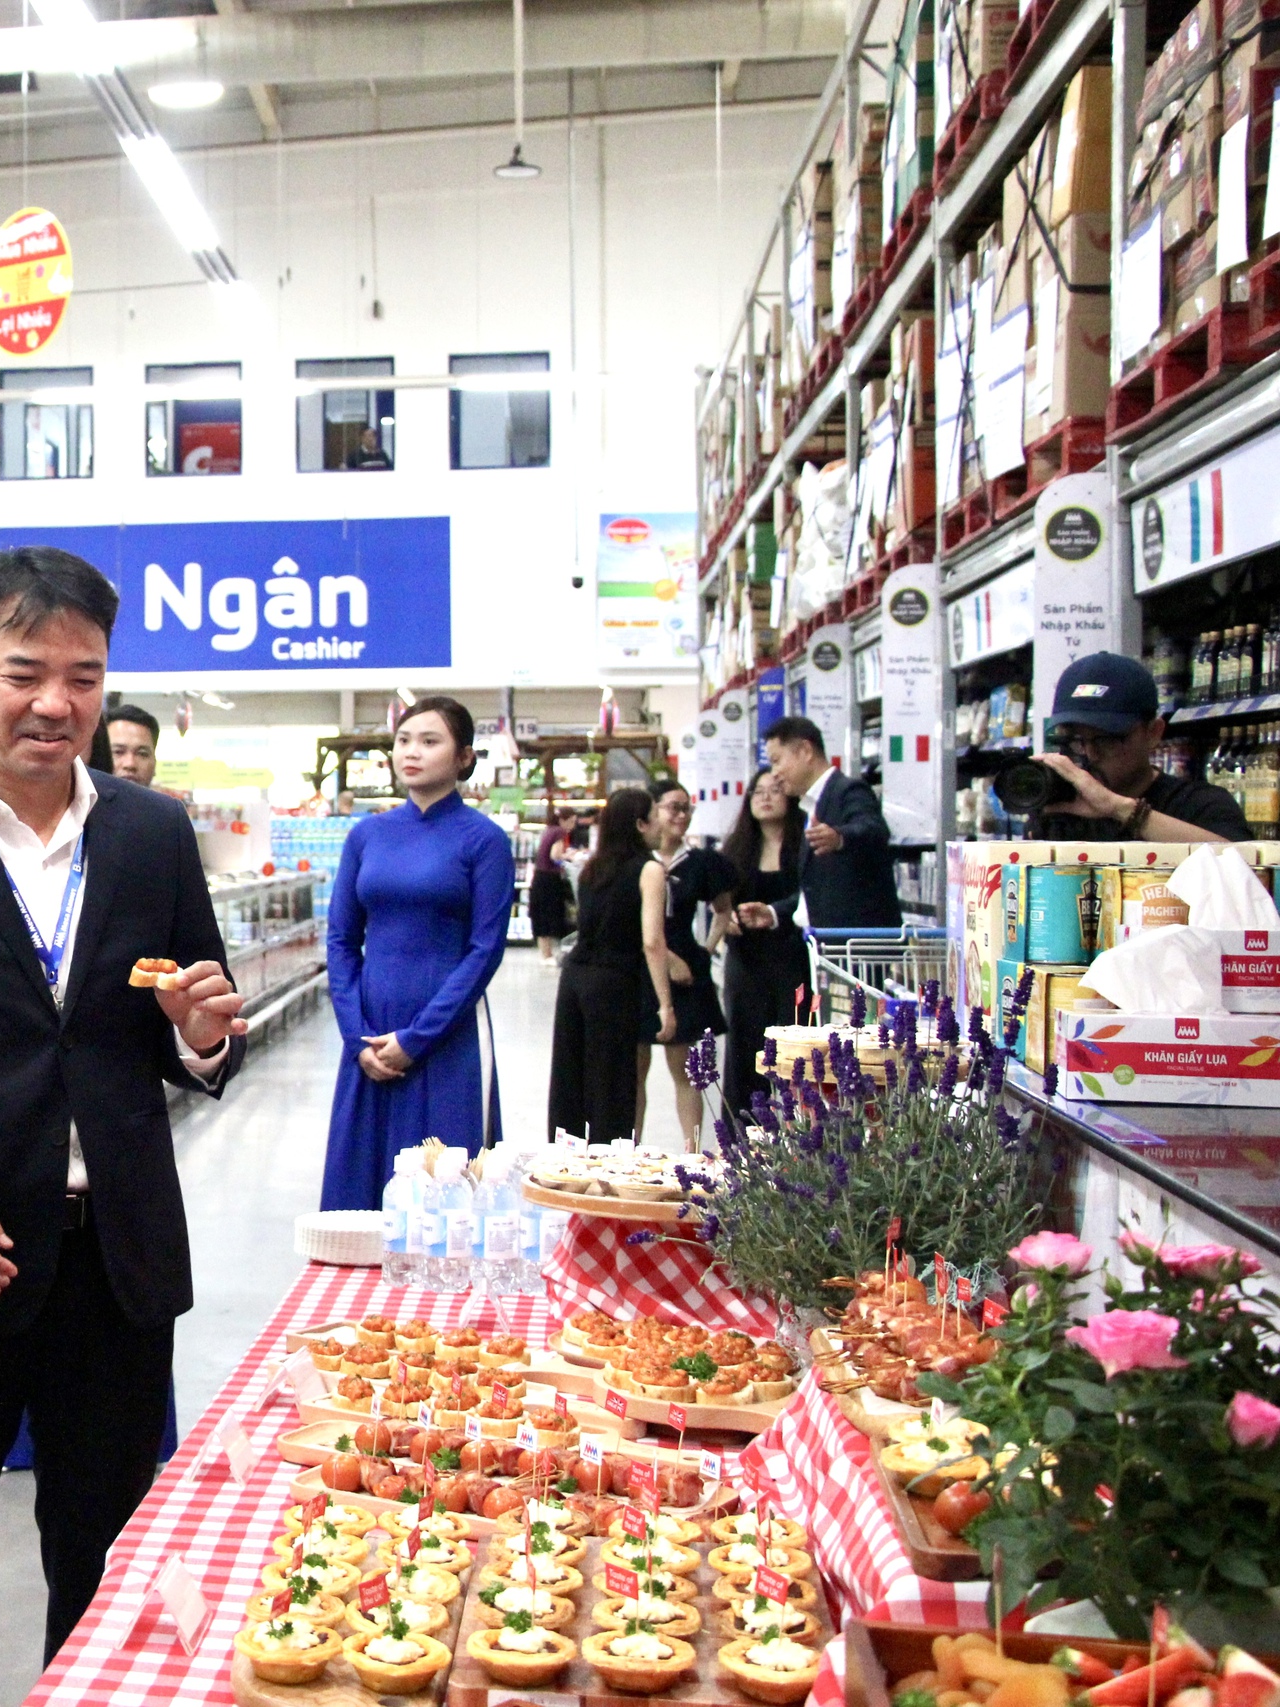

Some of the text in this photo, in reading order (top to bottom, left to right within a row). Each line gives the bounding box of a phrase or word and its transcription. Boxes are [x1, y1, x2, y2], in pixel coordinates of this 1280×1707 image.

[144, 556, 368, 652] Ngân
[1044, 604, 1065, 614] Sản
[1041, 618, 1105, 632] Nhập Khẩu
[272, 636, 365, 661] Cashier
[1145, 886, 1176, 900] HEIN
[1249, 960, 1273, 974] GIẤY
[1144, 1050, 1228, 1066] KHĂN GIẤY LỤA
[608, 1568, 634, 1584] Taste of
[759, 1569, 784, 1589] Taste of
[362, 1585, 377, 1596] Taste
[608, 1579, 631, 1593] the UK
[758, 1581, 779, 1597] the UK
